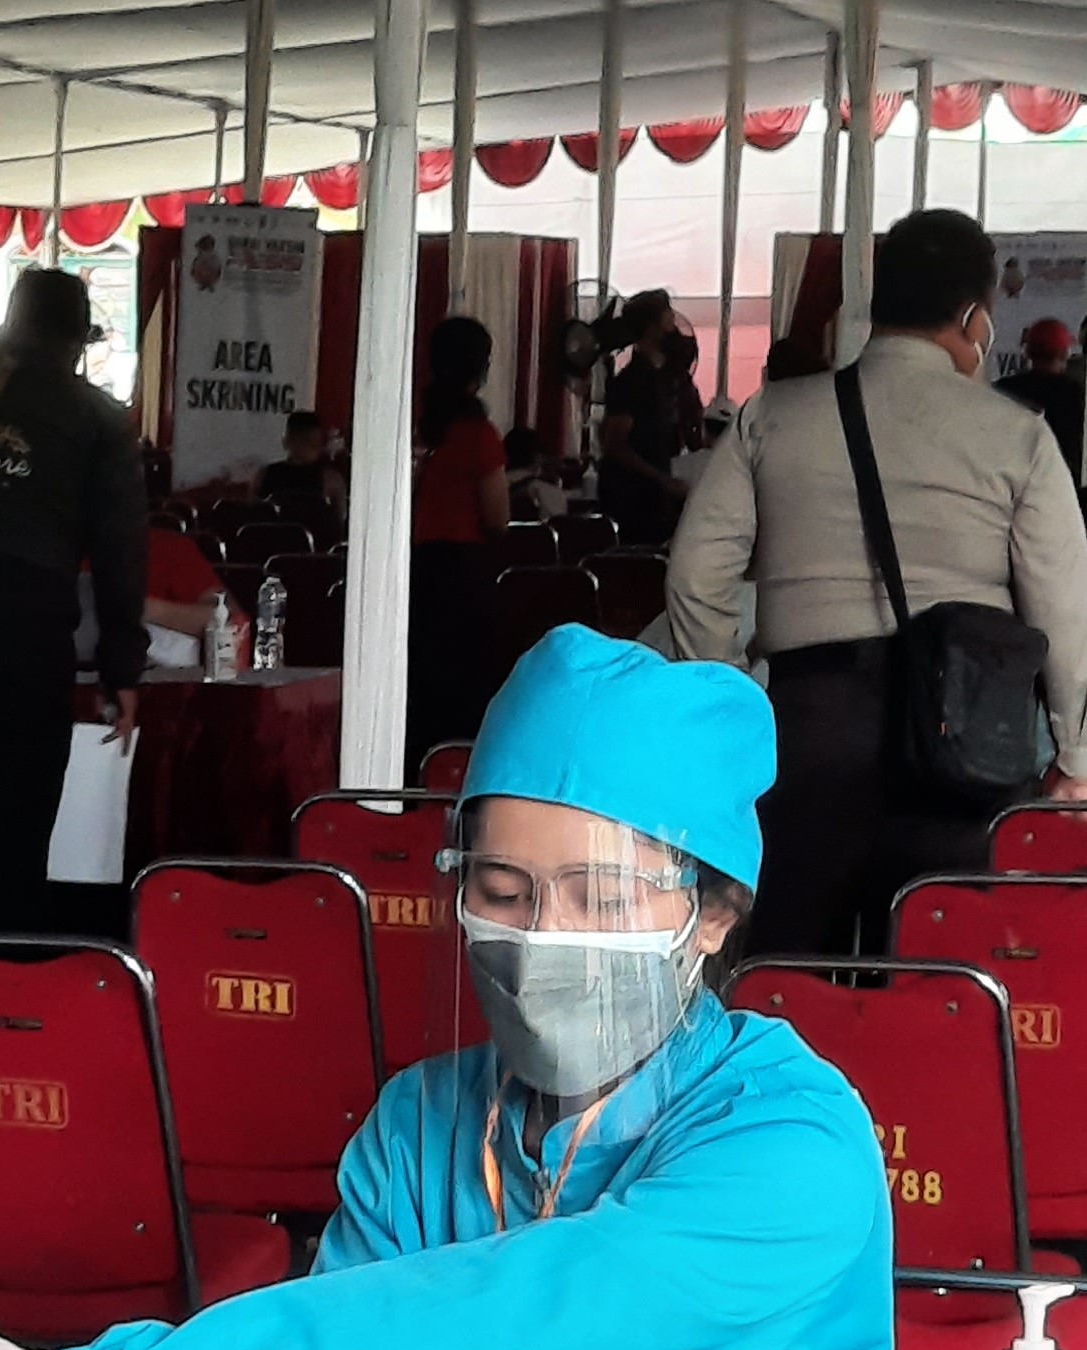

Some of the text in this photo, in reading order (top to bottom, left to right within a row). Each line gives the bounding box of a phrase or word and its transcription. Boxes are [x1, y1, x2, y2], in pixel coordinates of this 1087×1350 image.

[214, 340, 273, 373] AREA
[186, 378, 296, 414] SKRINING
[211, 976, 292, 1015] TRI
[1011, 1009, 1054, 1044] RI
